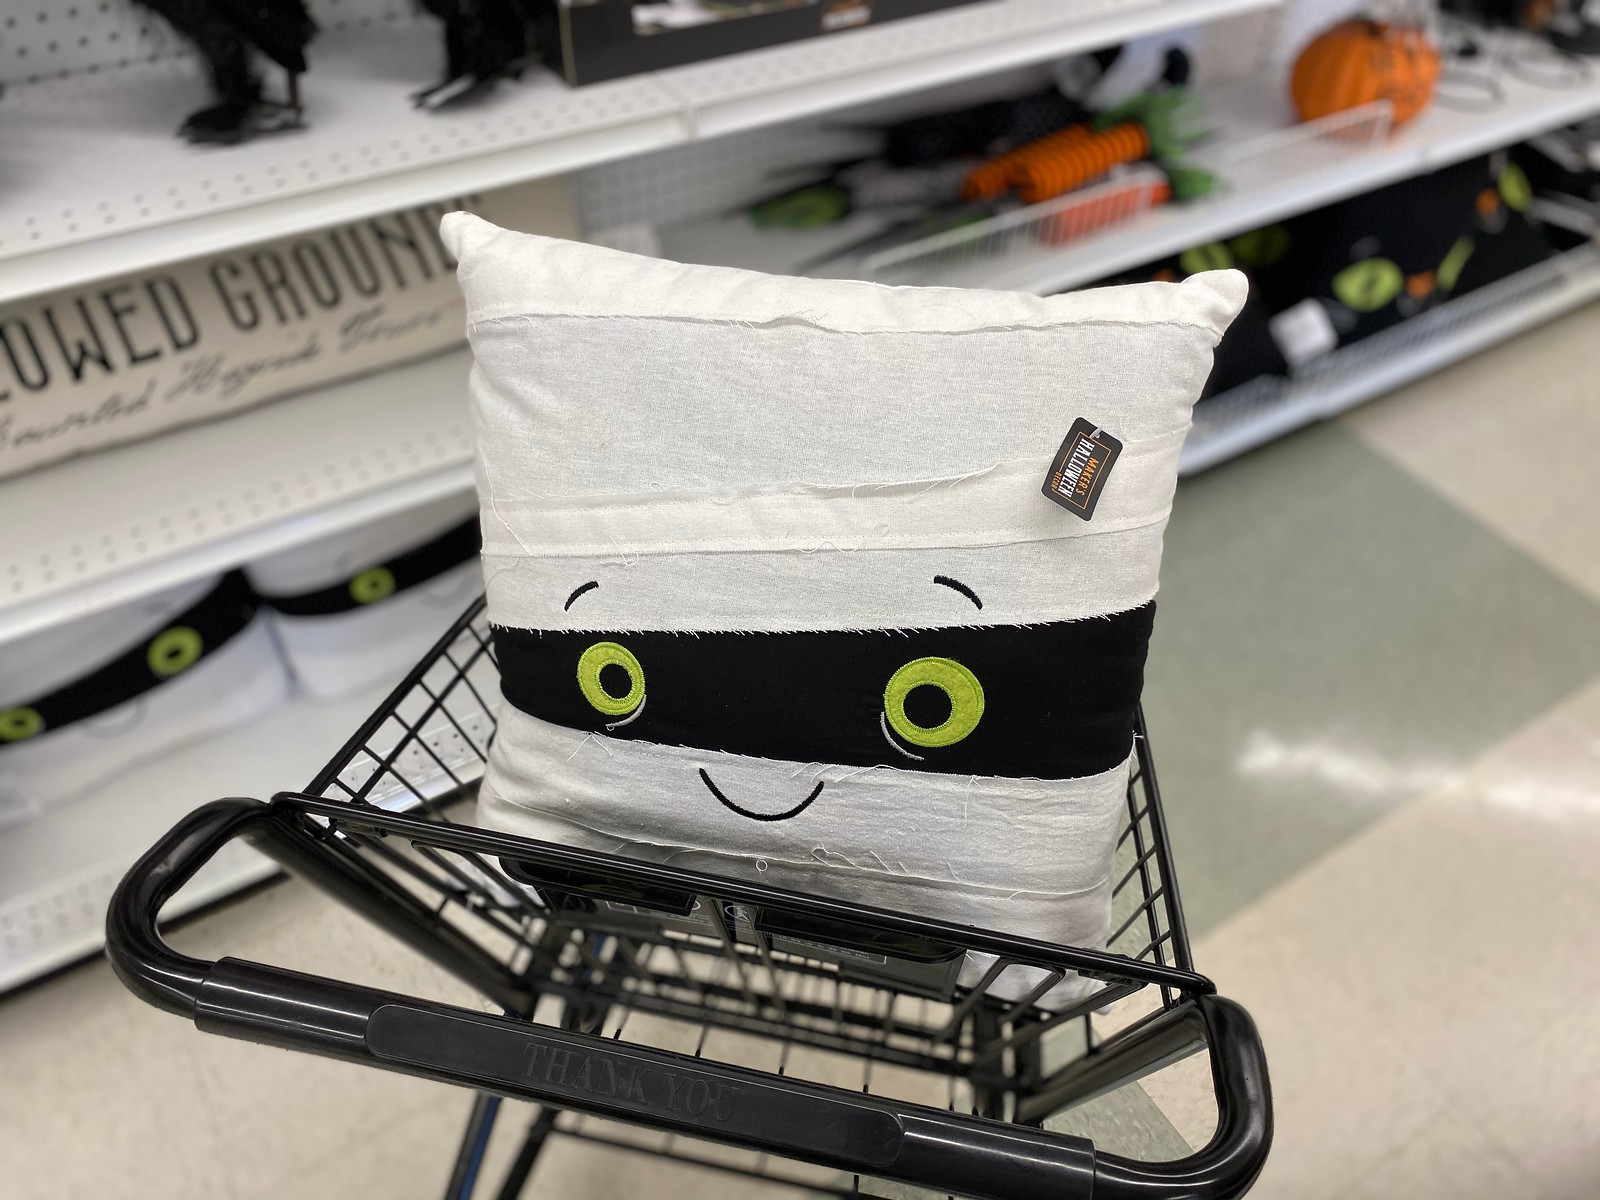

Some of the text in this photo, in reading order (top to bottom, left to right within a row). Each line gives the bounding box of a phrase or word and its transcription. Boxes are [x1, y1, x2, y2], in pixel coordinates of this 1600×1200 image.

[0, 274, 200, 402] OWED
[1057, 438, 1095, 498] HALLOWEEN
[1075, 457, 1100, 496] MAKER'S
[521, 1042, 744, 1122] THANK YOU
